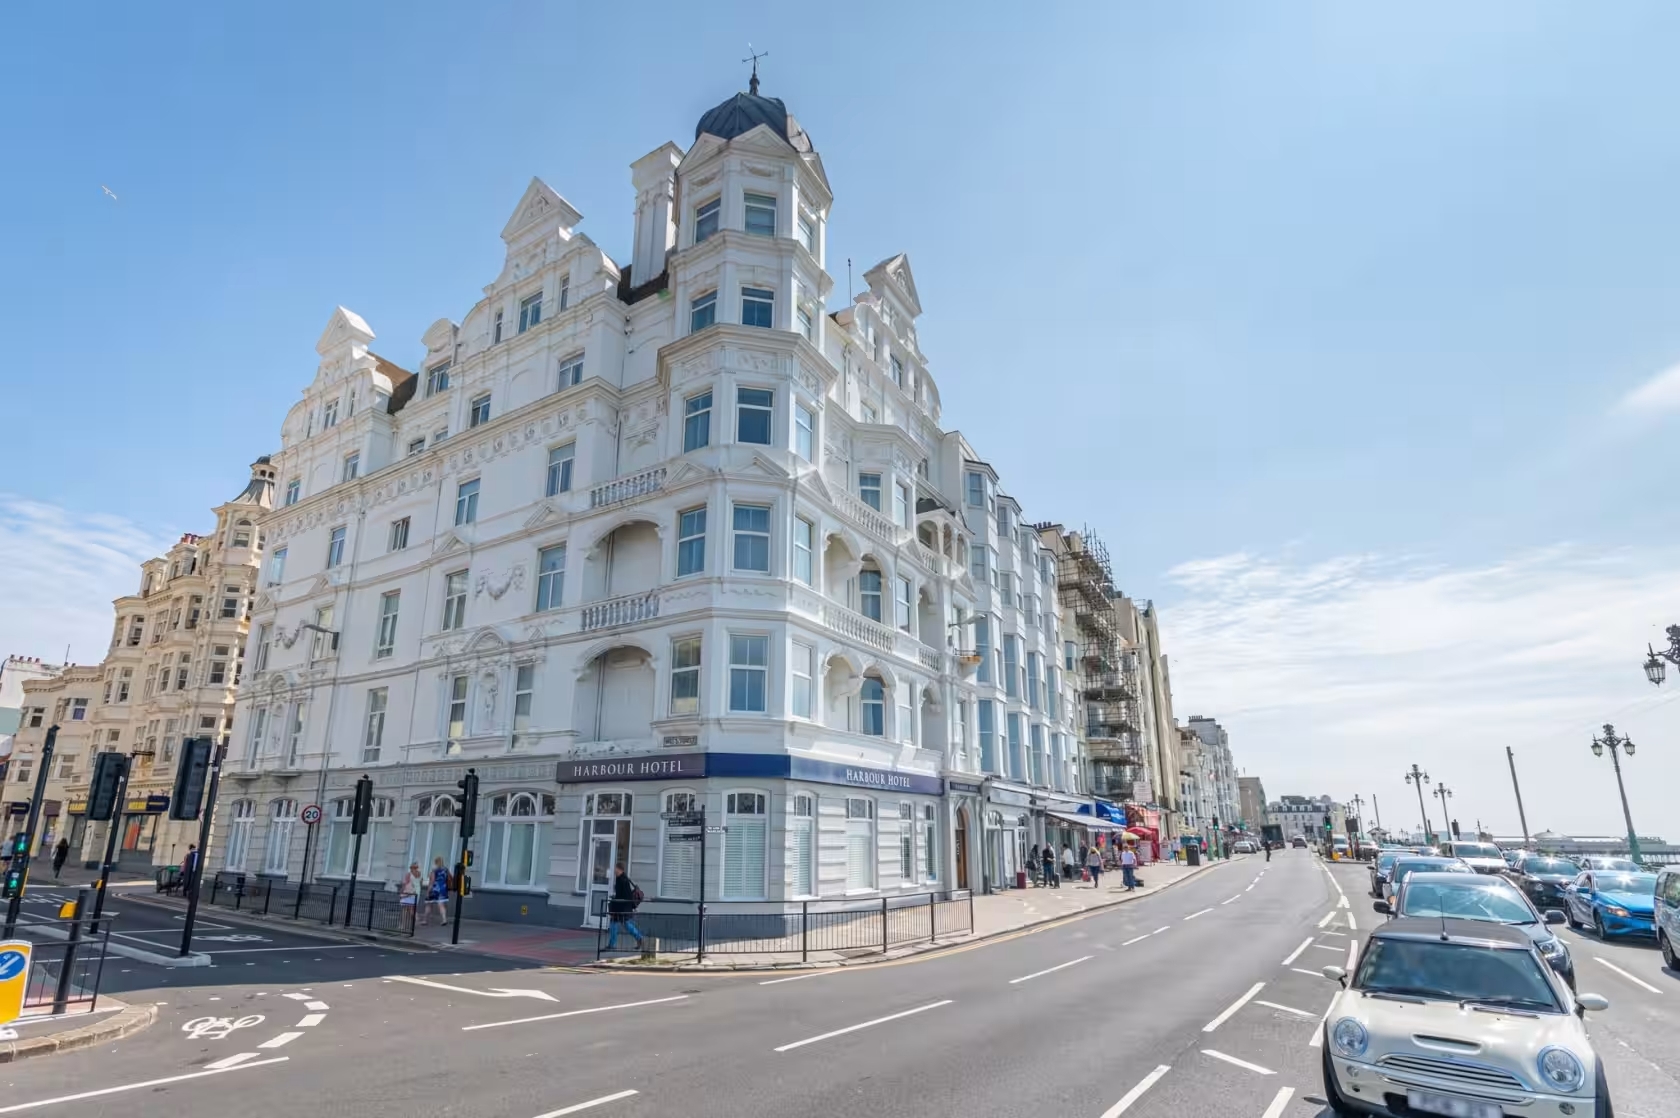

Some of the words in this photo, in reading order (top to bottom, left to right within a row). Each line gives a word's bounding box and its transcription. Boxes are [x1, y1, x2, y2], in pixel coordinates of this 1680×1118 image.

[574, 764, 634, 776] HARBOUR
[640, 760, 684, 774] HOTEL
[846, 769, 886, 784] HARBOUR
[888, 774, 910, 787] HOTEL
